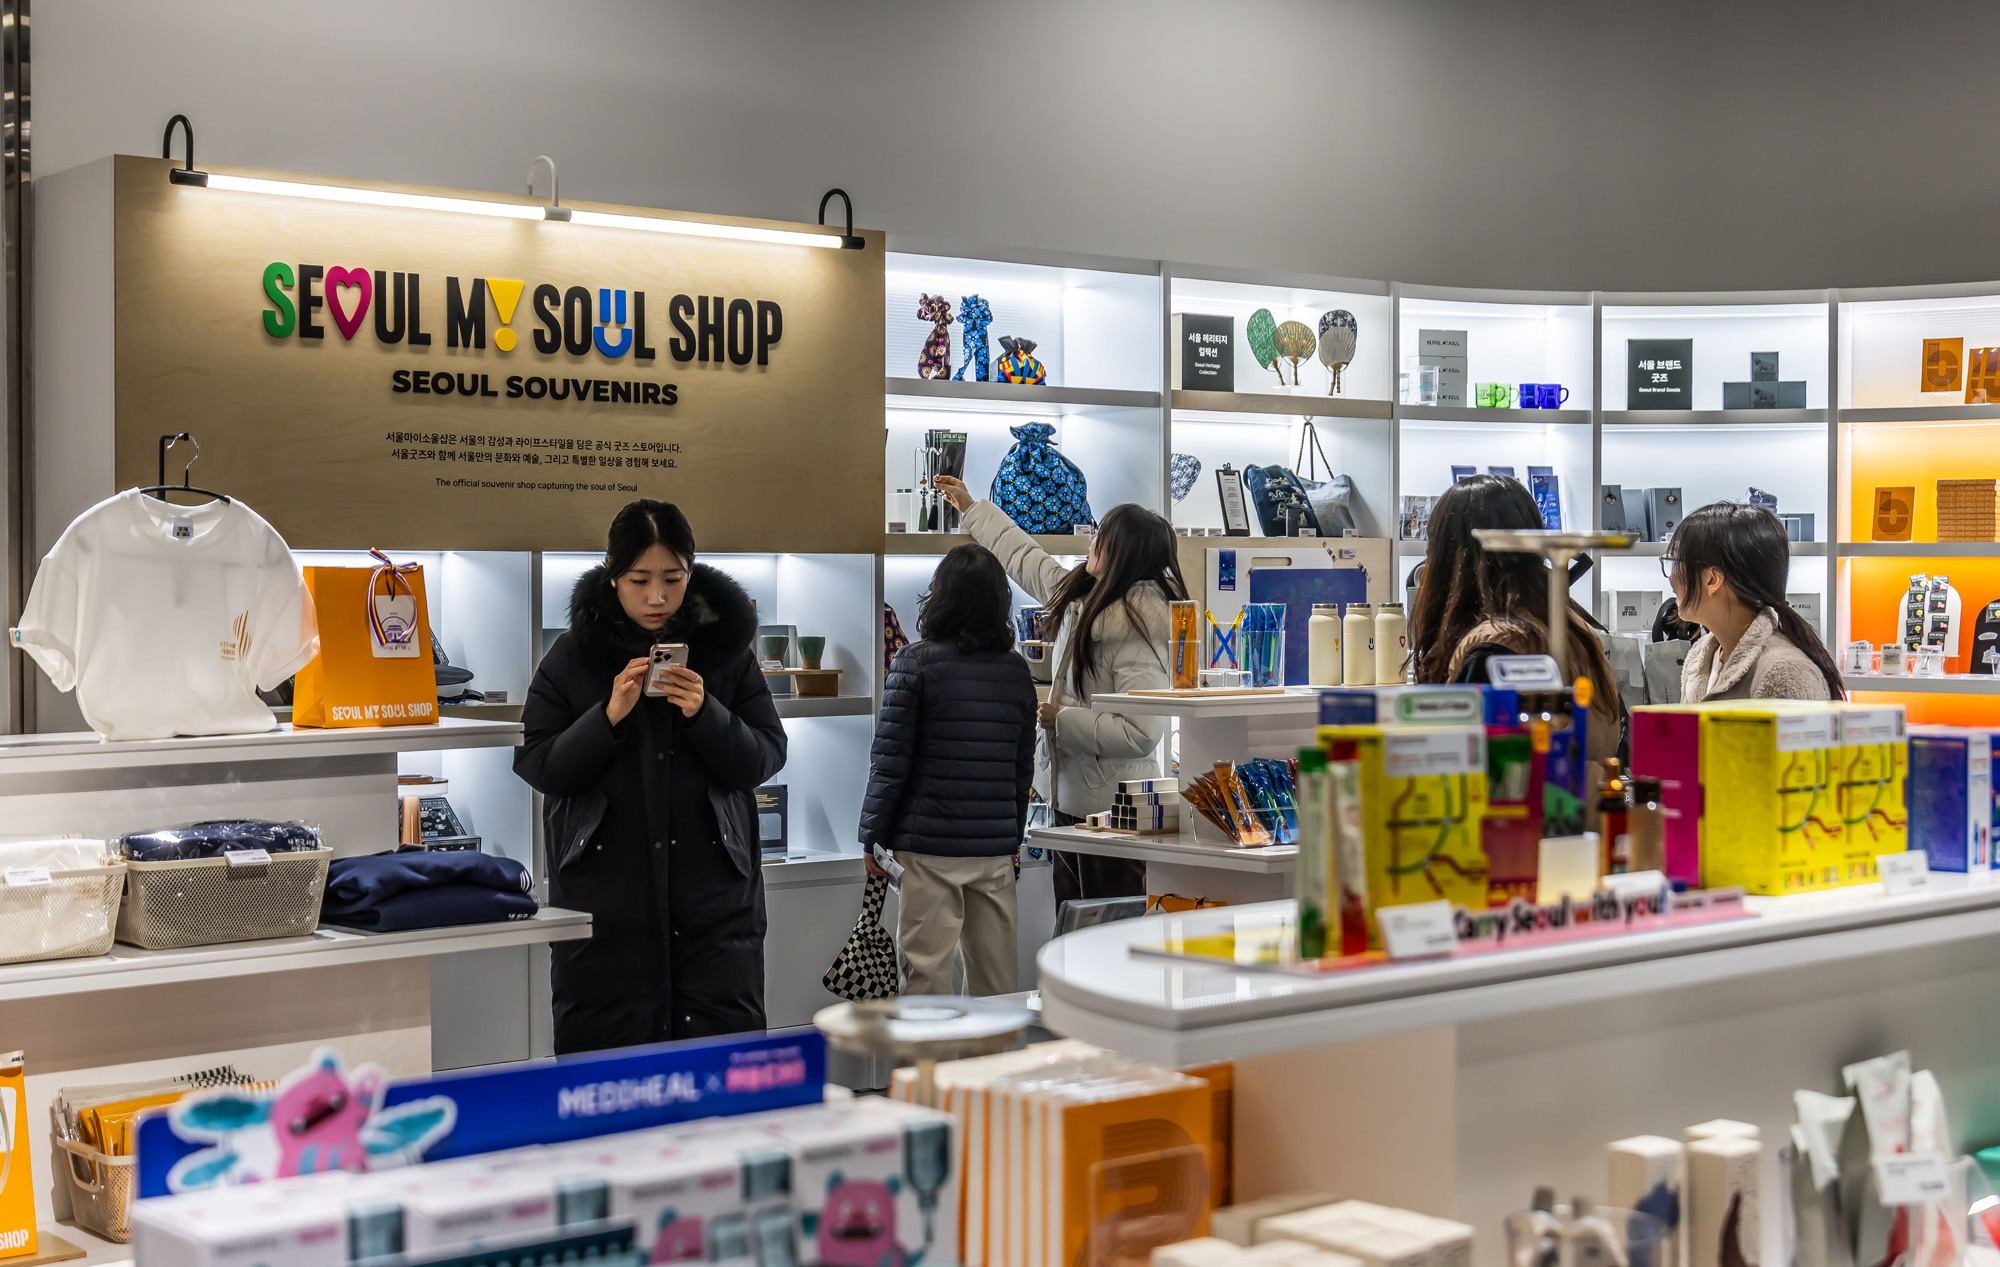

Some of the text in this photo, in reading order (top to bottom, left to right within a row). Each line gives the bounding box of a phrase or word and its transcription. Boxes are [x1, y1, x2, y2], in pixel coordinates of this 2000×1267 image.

[263, 262, 432, 346] SEOUL
[533, 283, 656, 360] SOUL
[668, 294, 783, 366] SHOP
[1188, 332, 1228, 345] 서울 헤리티지
[1198, 346, 1218, 358] 컬렉션
[1638, 360, 1682, 370] 서울 브랜드
[1651, 373, 1668, 383] 굿즈
[392, 370, 678, 406] SEOUL SOUVENIRS
[386, 432, 682, 454] 서울마이소울샵은 서울의 감성과 라이프스타일을 담은 공식 굿즈 스토어입니다.
[391, 448, 678, 469] 서울굿즈와 함께 서울만의 문화와 예술, 그리고 특별한 일상을 경험해 보세요.
[435, 477, 638, 492] The official souvenir shop capturing the soul of Seoul
[332, 706, 363, 720] SEOUL
[381, 704, 406, 718] SOUL
[408, 702, 433, 717] SHOP
[1512, 895, 1571, 934] Seoul
